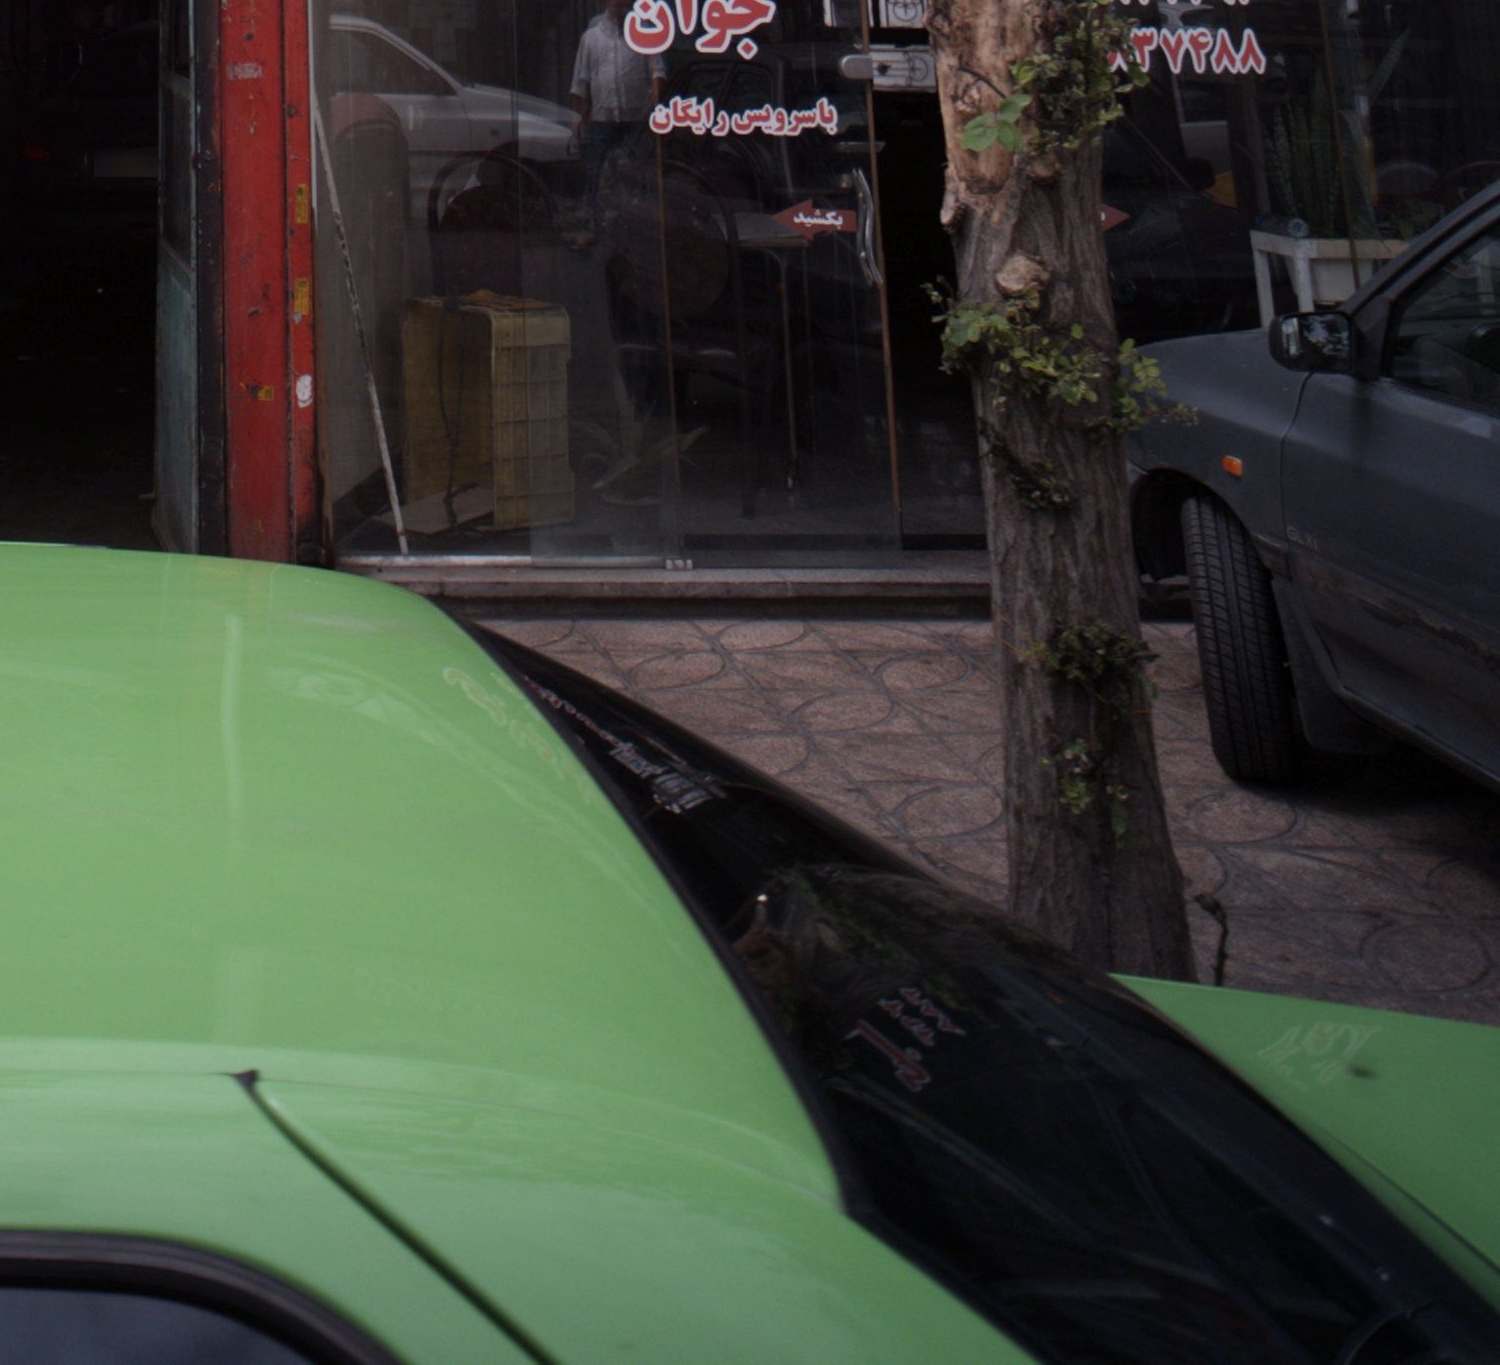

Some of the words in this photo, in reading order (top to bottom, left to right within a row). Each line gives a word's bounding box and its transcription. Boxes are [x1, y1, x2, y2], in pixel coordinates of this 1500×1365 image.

[1108, 26, 1267, 75] ۳۷۴۸۸
[649, 94, 729, 137] رایگان
[731, 103, 815, 137] سرویس
[792, 208, 844, 229] بکشید
